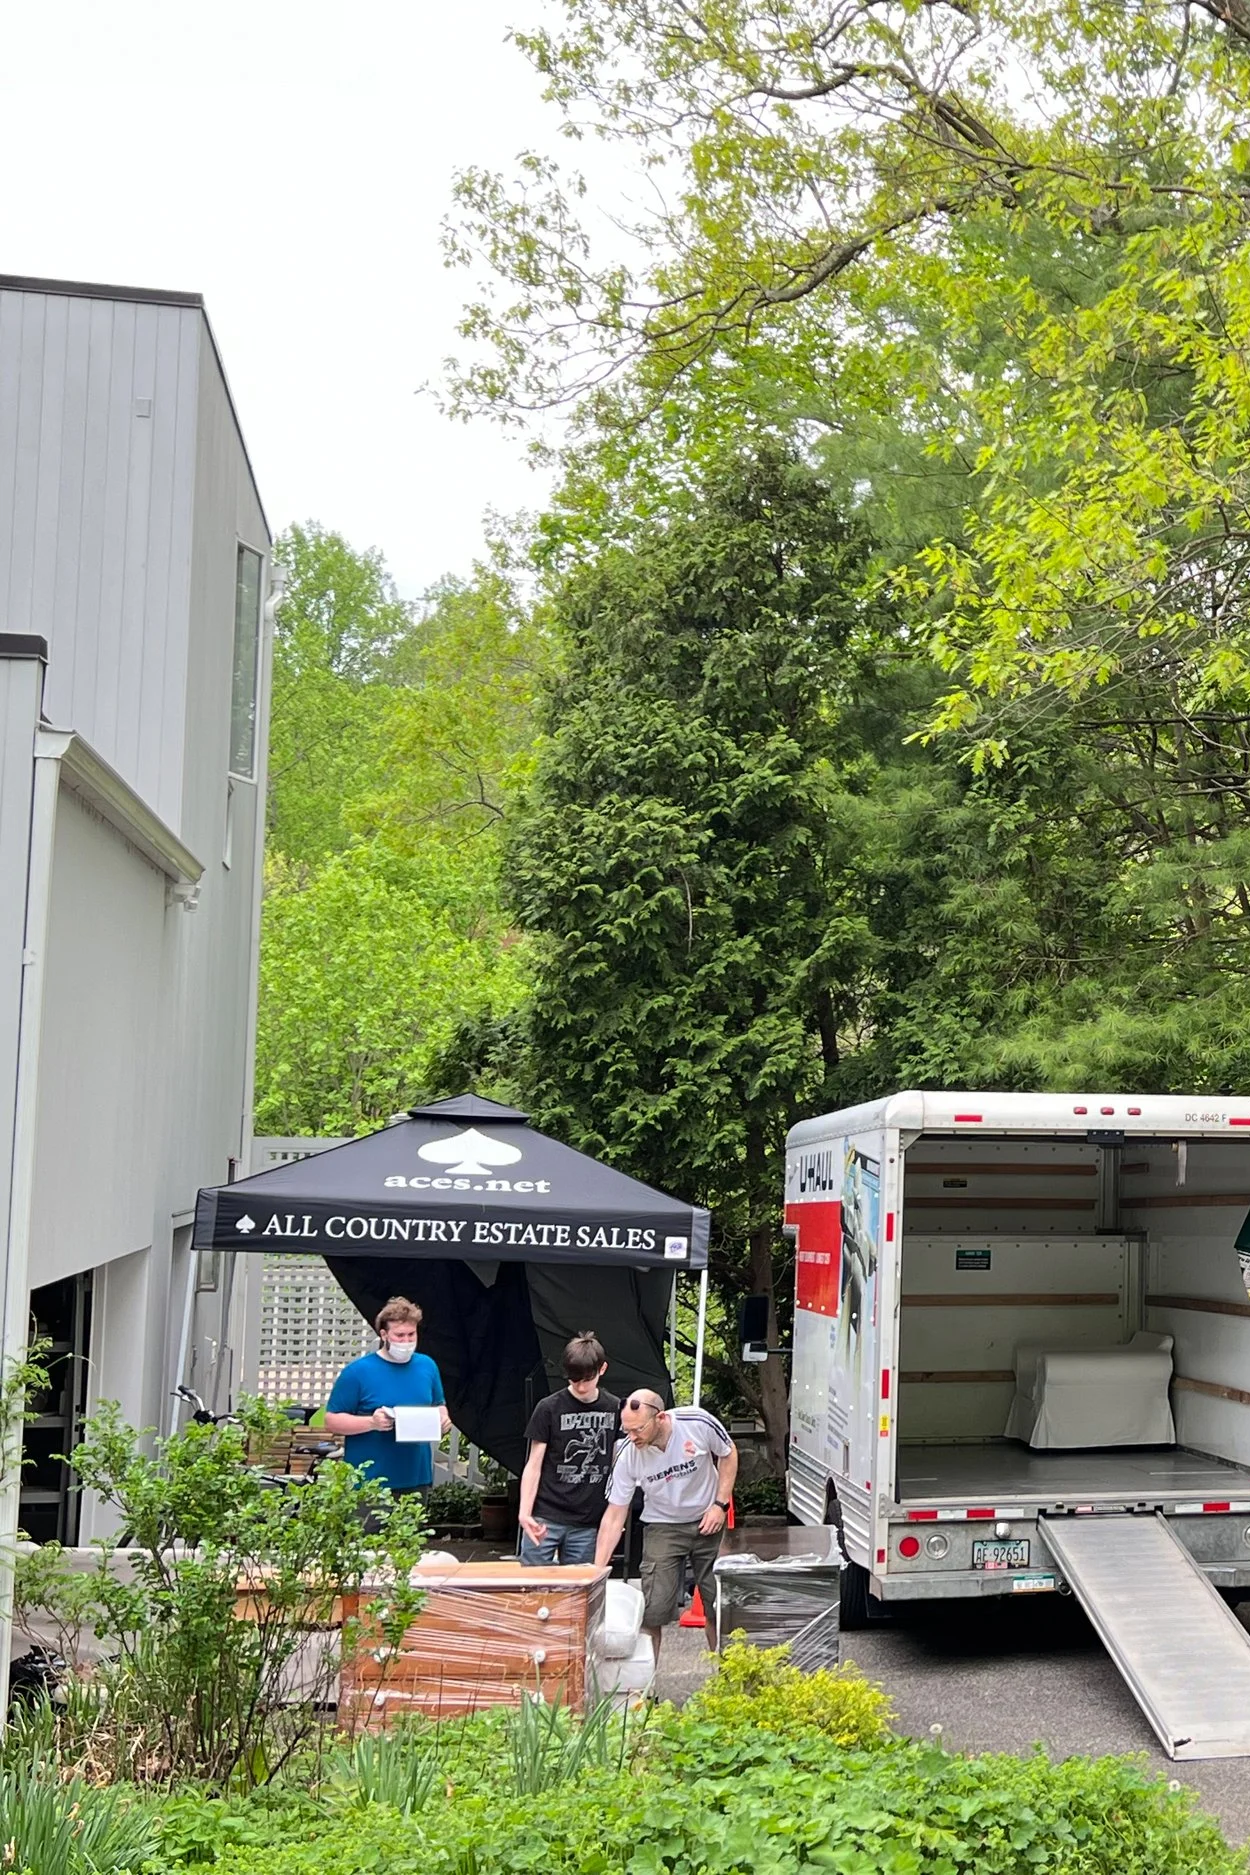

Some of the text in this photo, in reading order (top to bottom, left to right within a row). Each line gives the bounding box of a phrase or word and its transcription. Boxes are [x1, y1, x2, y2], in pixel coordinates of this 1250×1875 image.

[1185, 1113, 1198, 1122] DC
[1222, 1113, 1227, 1122] F
[383, 1175, 551, 1194] aces.net
[262, 1213, 318, 1237] ALL
[325, 1216, 467, 1242] COUNTRY
[472, 1221, 571, 1247] ESTATE
[576, 1226, 656, 1250] SALES
[646, 1459, 696, 1483] SIEMENS
